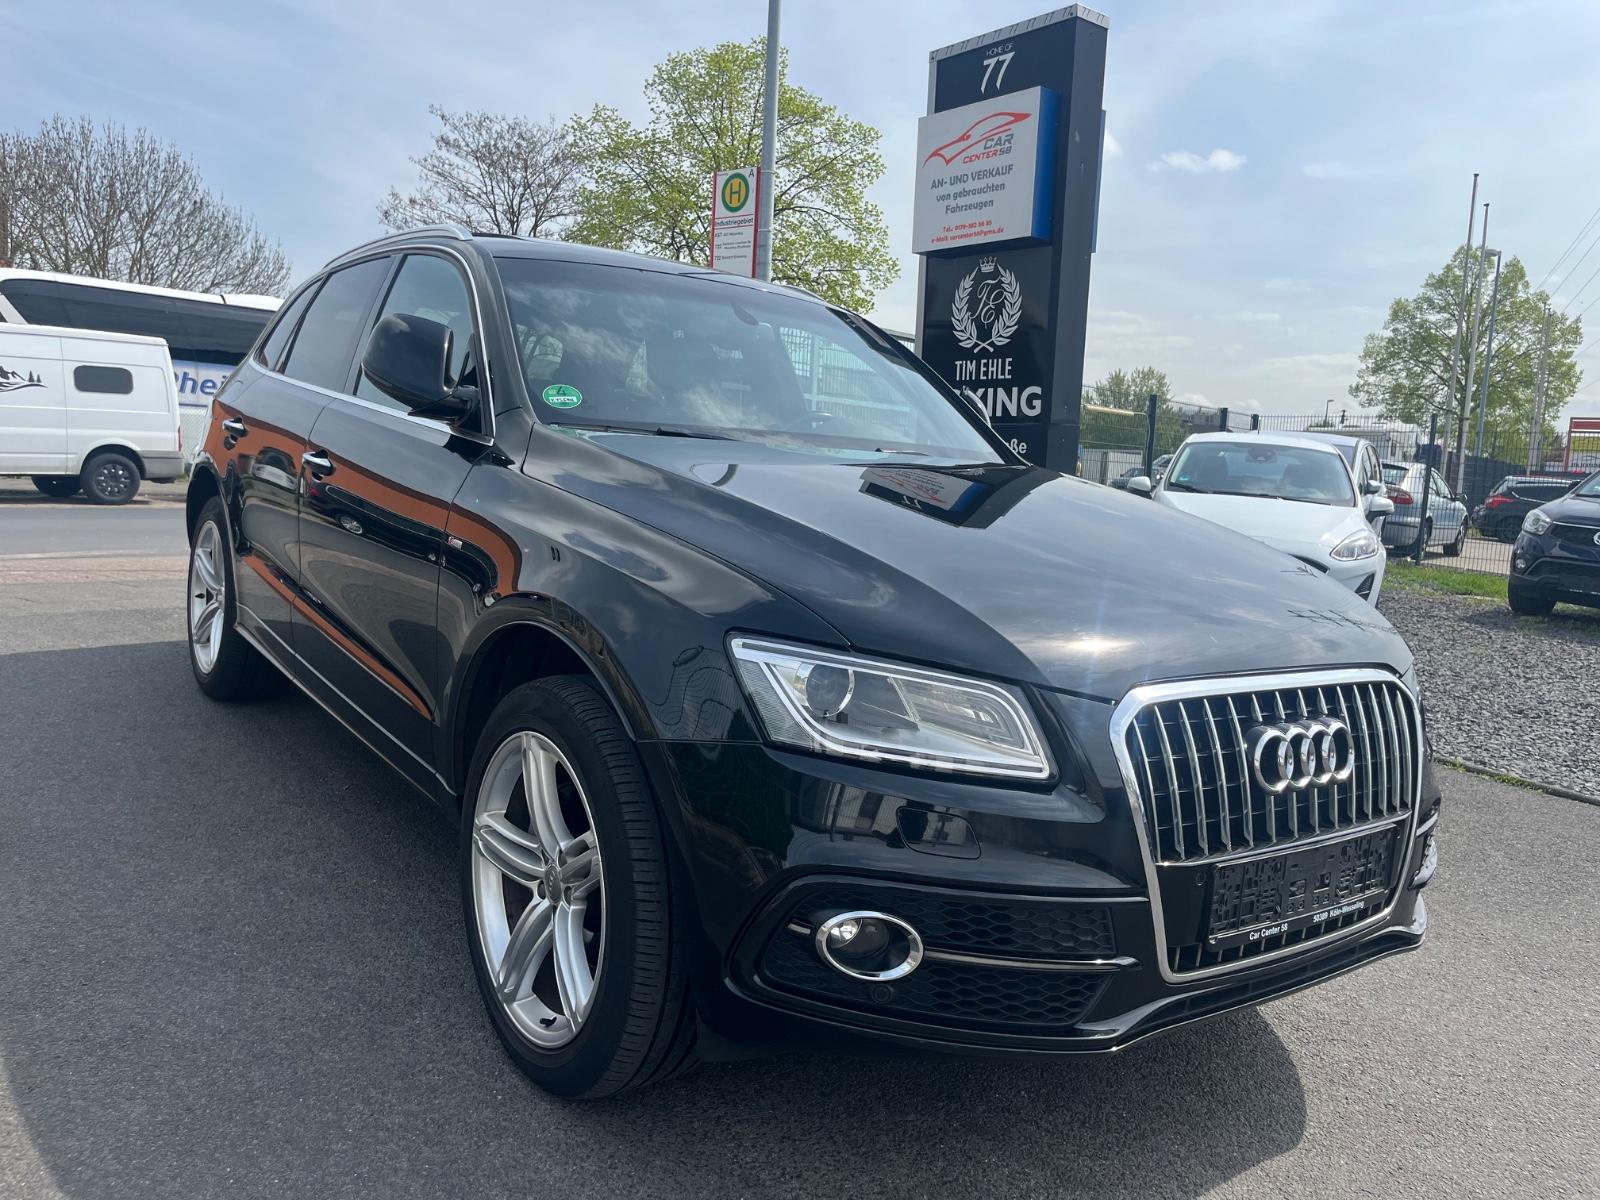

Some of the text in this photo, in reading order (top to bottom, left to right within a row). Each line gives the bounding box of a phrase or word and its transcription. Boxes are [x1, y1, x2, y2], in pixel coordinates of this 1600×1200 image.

[981, 51, 1015, 94] 77
[983, 133, 1014, 150] CAR
[748, 168, 755, 178] A
[930, 164, 1014, 190] AN- UND VERKAUF
[729, 180, 741, 205] H
[936, 182, 1006, 202] von gebrauchten
[945, 199, 994, 214] Fahrzeugen
[955, 357, 1013, 381] TIM EHLE
[1006, 438, 1027, 454] ße
[1249, 923, 1288, 940] Car Center 58
